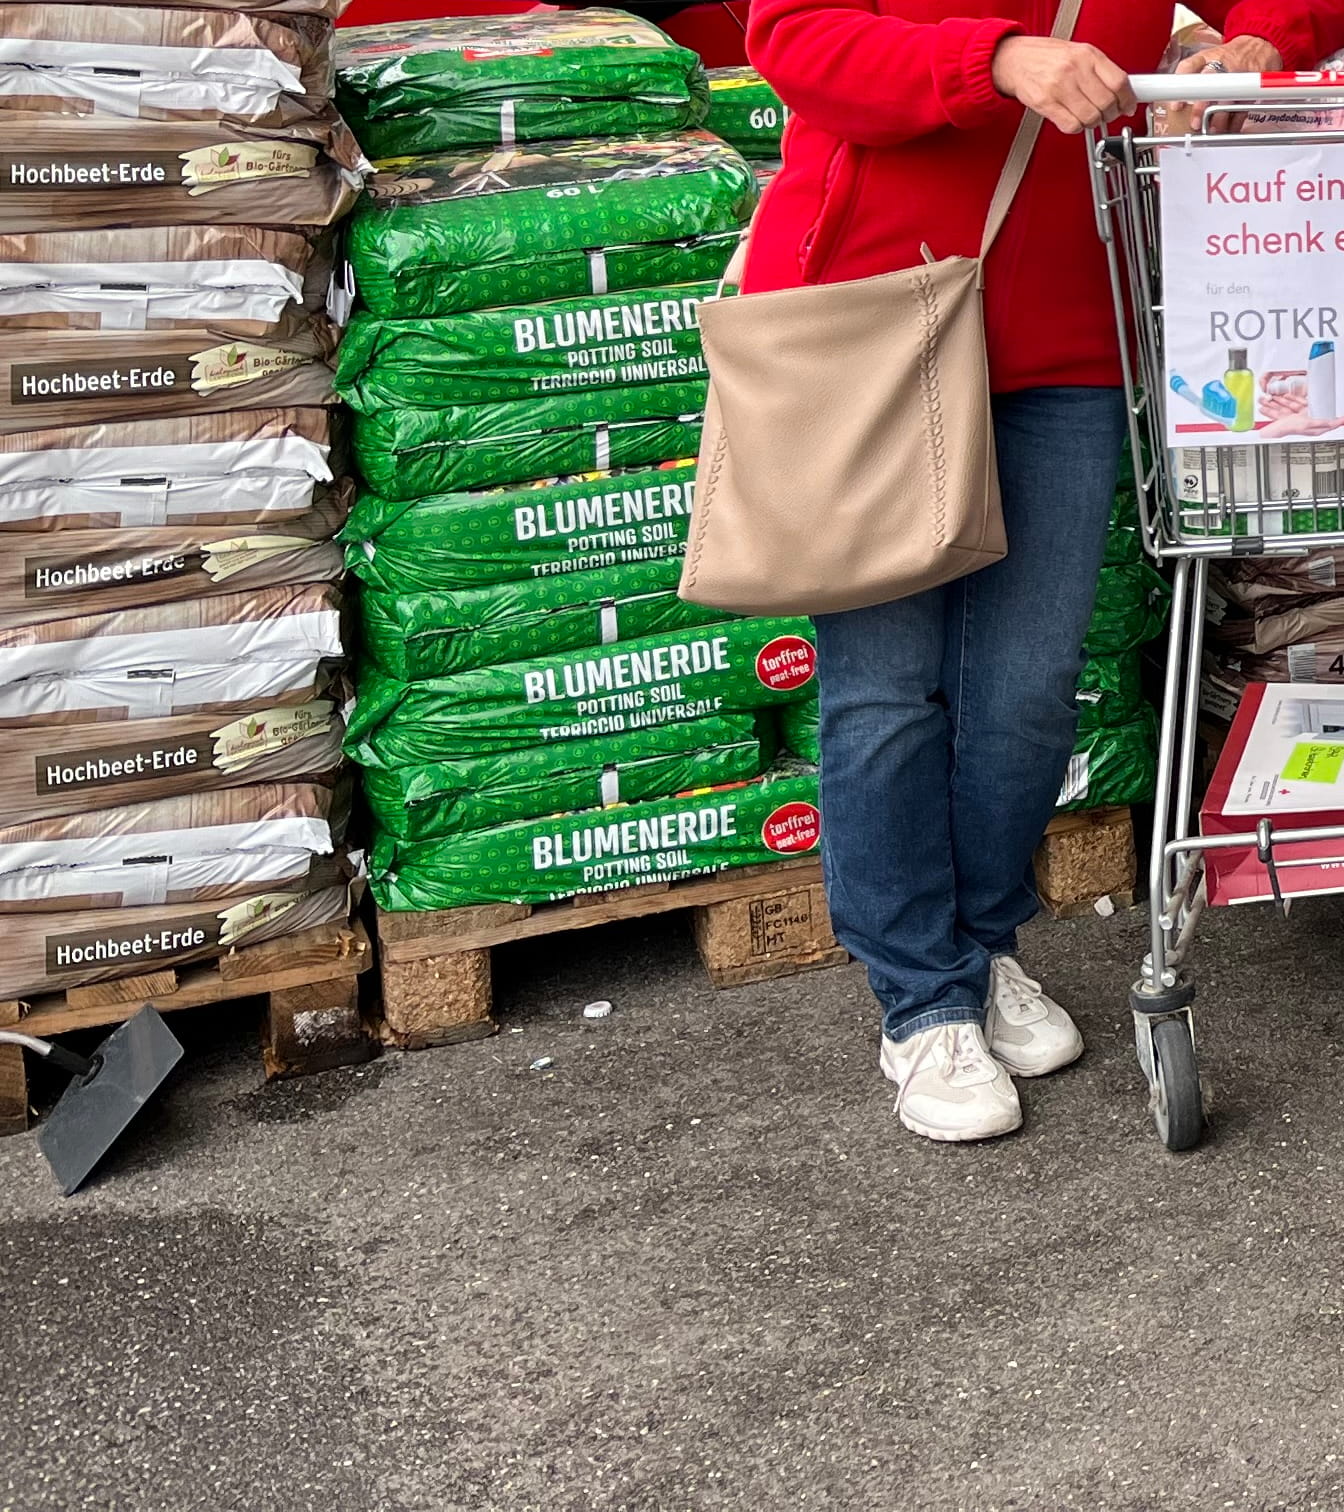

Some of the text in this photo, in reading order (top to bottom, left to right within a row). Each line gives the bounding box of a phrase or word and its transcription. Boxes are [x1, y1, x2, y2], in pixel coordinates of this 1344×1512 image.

[750, 107, 777, 129] 60
[11, 162, 166, 185] Hochbeet-Erde
[1206, 169, 1287, 205] Kauf
[1205, 220, 1326, 257] schenk
[1205, 281, 1252, 296] für den
[514, 296, 720, 354] BLUMENERD
[567, 338, 677, 369] POTTING SOIL
[22, 366, 175, 397] Hochbeet-Erde
[531, 355, 708, 392] TERRICCIO UNIVERSAL
[567, 521, 678, 553] POTTING SOIL
[35, 554, 186, 589] Hochbeet-Erde
[524, 636, 731, 705] BLUMENERDE
[762, 645, 809, 671] torffrei
[769, 663, 810, 685] peat-free
[577, 684, 686, 717] POTTING SOIL
[540, 696, 723, 740] TERRICCIO UNIVERSALE
[46, 746, 198, 786] Hochbeet-Erde
[532, 803, 738, 871] BLUMENERDE
[769, 812, 816, 836] torffrei
[776, 827, 817, 850] peat-free
[583, 849, 692, 882] POTTING SOIL
[765, 903, 782, 916] GB
[56, 926, 206, 965] Hochbeet-Erde
[766, 931, 787, 946] HT
